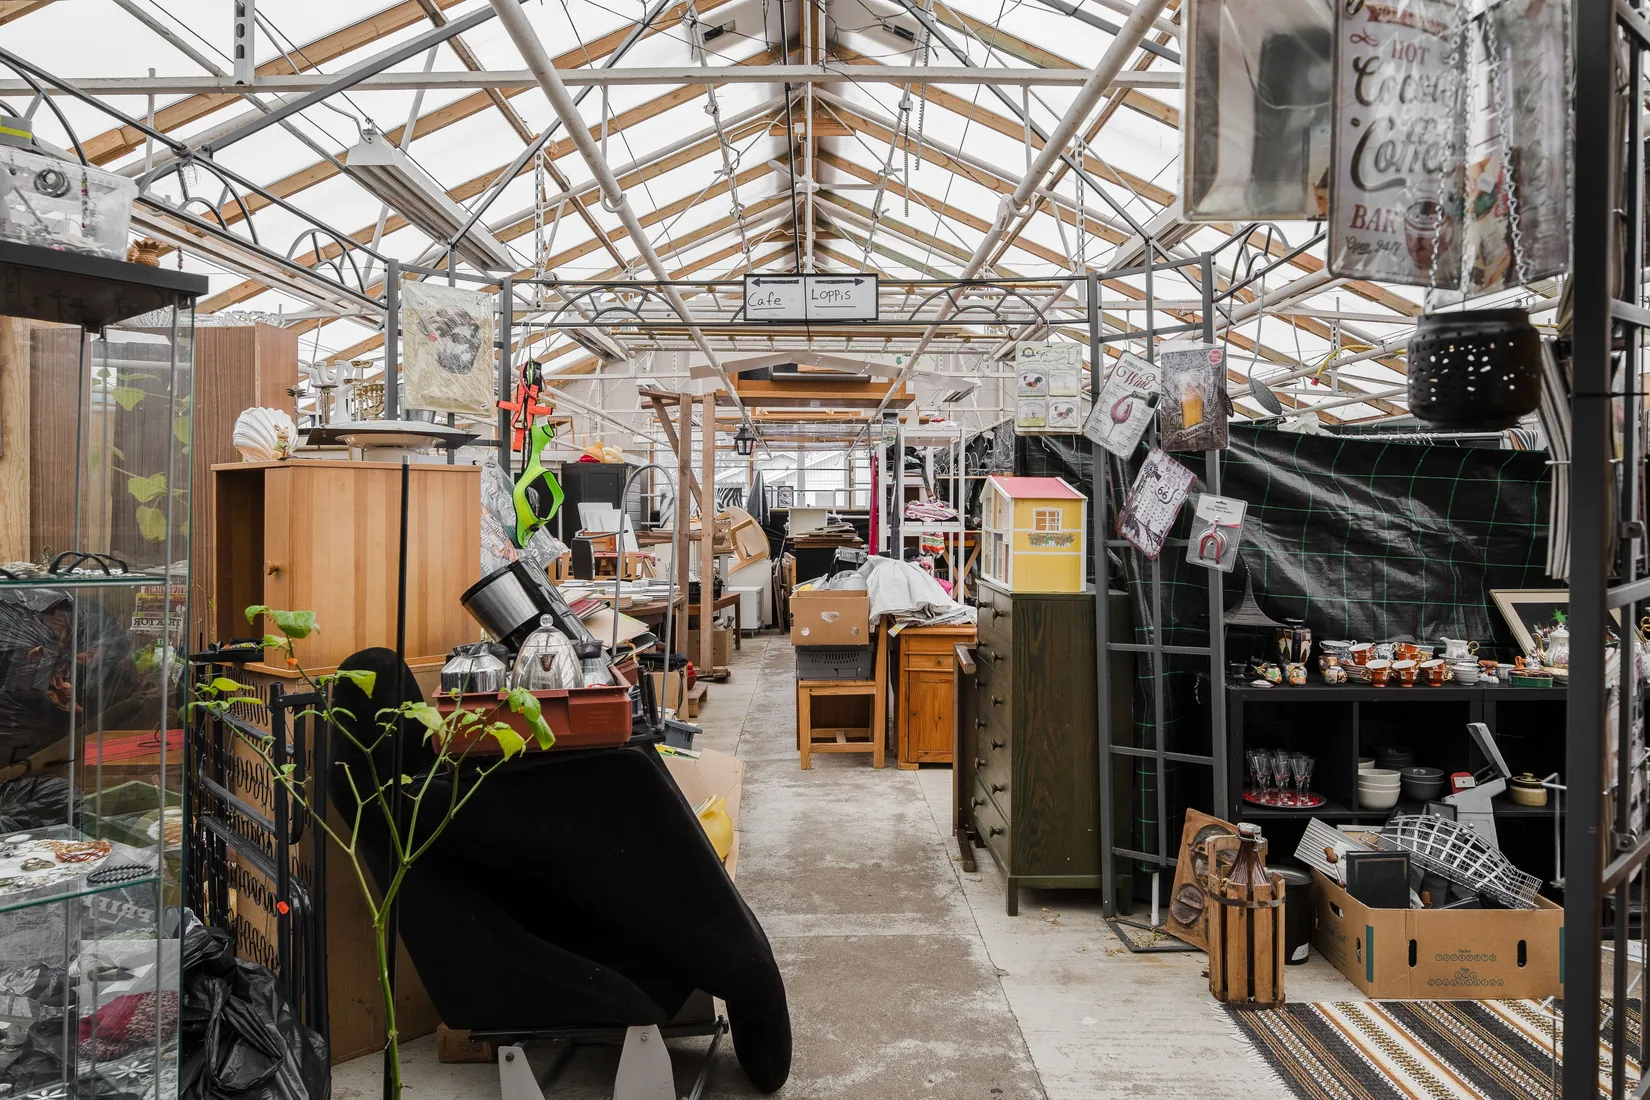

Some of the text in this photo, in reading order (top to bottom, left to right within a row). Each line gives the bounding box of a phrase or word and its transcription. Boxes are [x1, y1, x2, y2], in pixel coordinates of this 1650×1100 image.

[747, 291, 782, 307] Cafe
[811, 288, 851, 303] Loppis
[1120, 368, 1153, 390] Wine
[1157, 486, 1169, 500] 66
